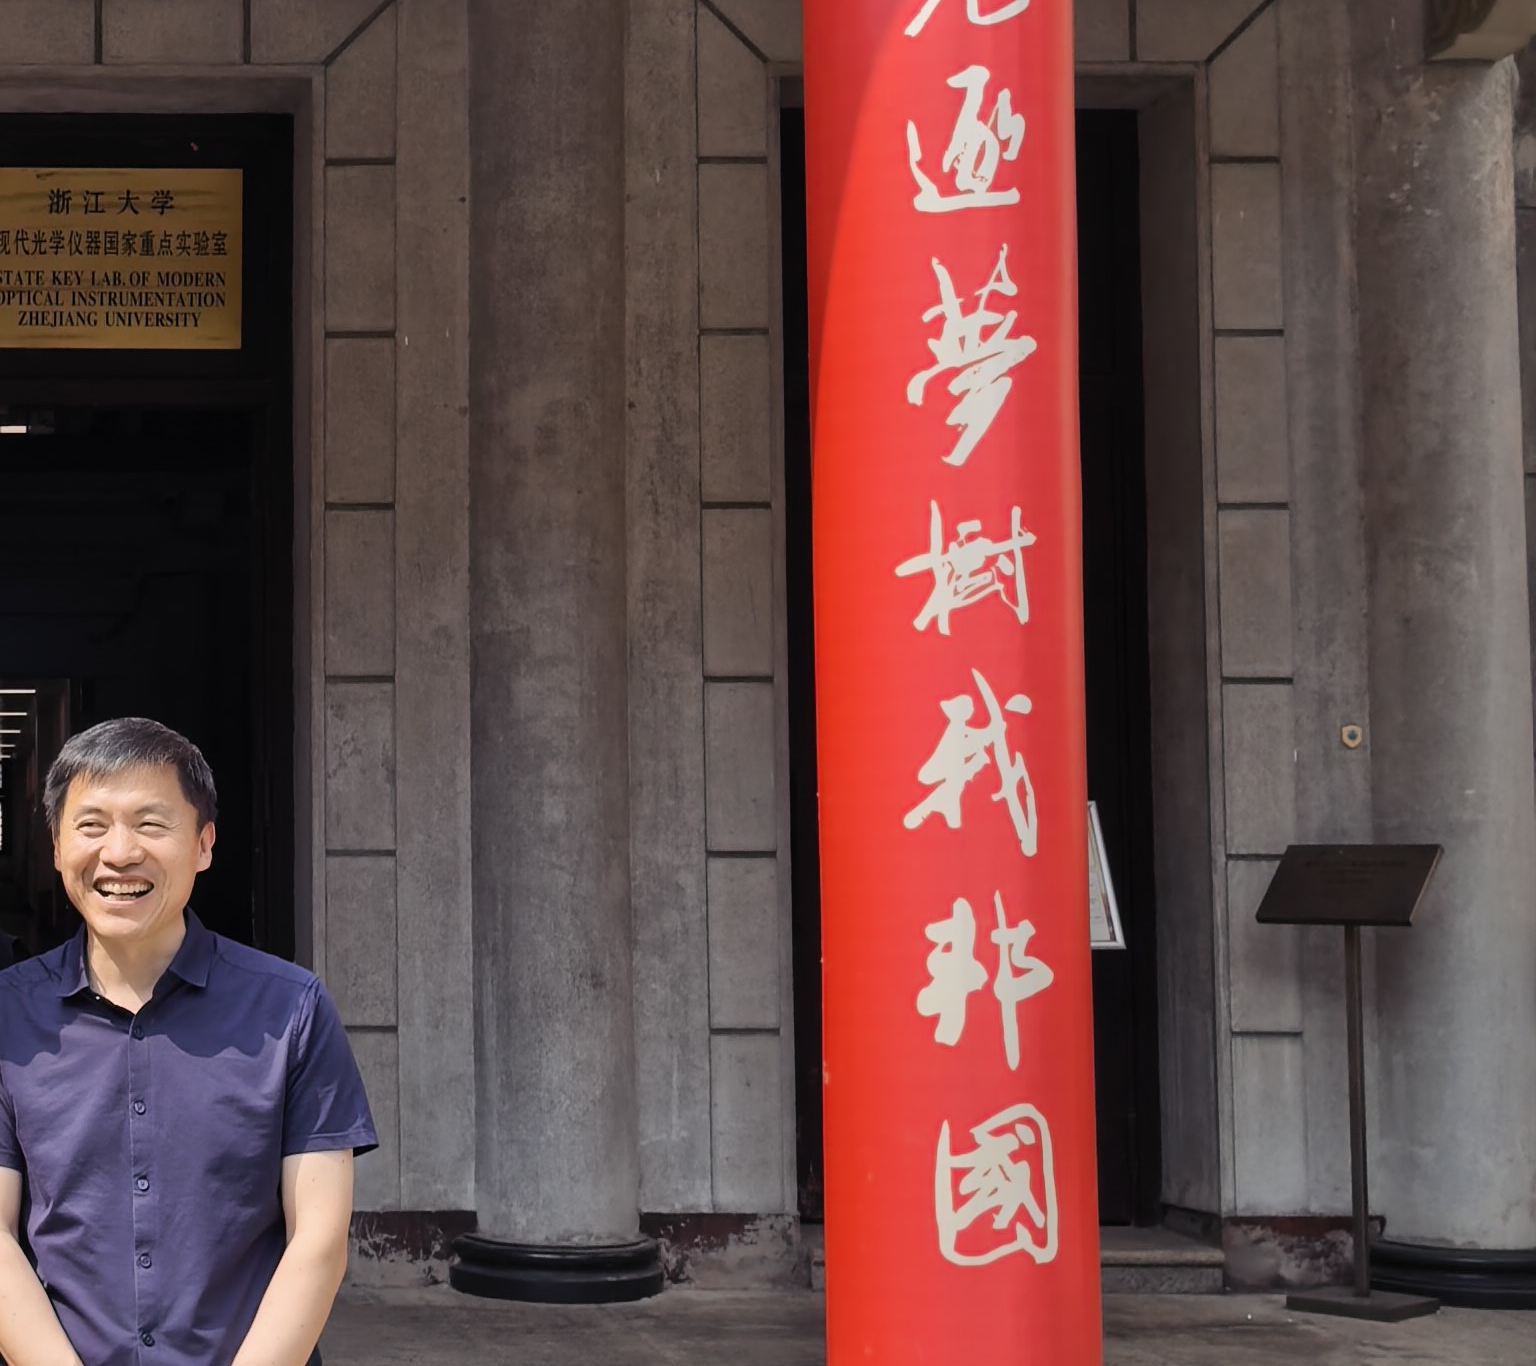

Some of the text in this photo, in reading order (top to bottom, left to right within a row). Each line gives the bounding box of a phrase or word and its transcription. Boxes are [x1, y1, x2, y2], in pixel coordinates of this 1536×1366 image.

[48, 188, 176, 216] 浙江大学
[51, 271, 84, 286] KEY
[91, 271, 126, 287] LAB.
[129, 271, 151, 287] OF
[157, 271, 226, 287] MODERN
[71, 291, 226, 307] INSTRUMENTATION
[18, 311, 202, 328] ZHEJIANG UNIVERSITY
